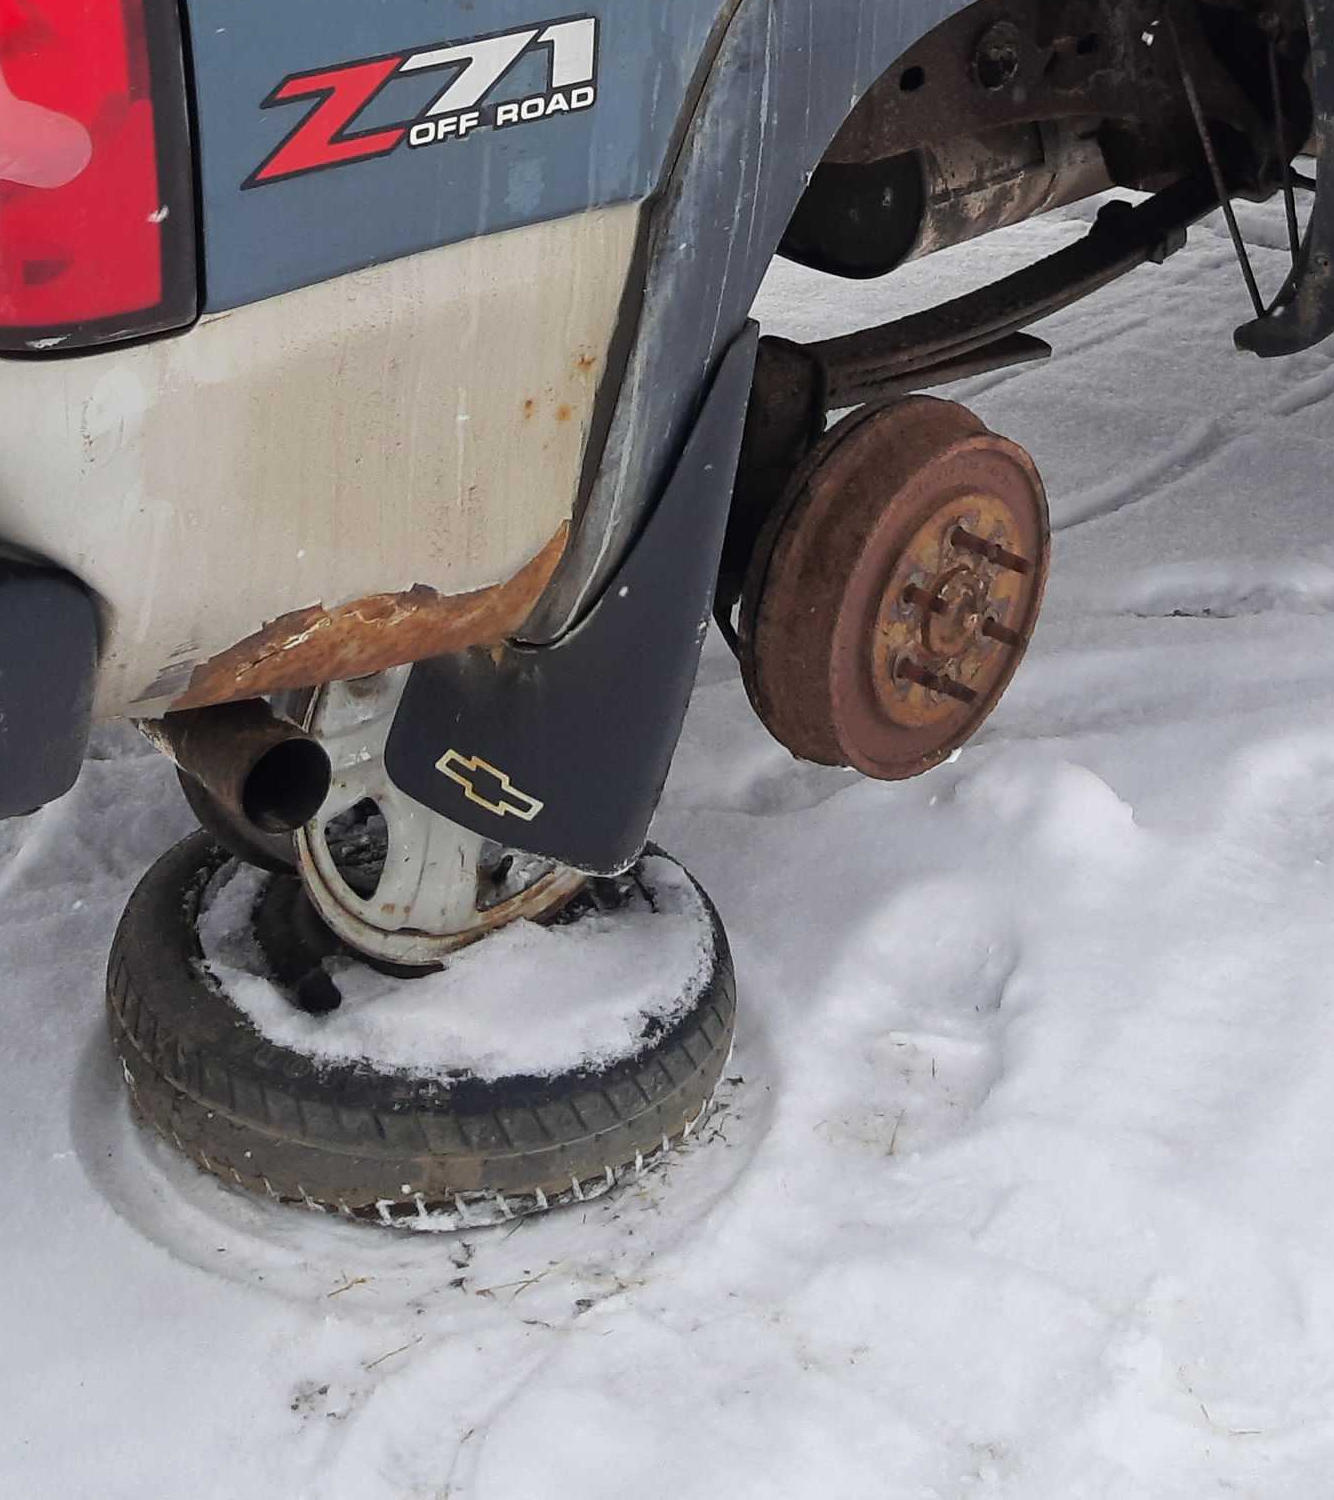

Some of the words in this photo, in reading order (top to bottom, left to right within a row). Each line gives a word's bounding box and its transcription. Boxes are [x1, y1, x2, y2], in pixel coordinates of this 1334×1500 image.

[249, 16, 598, 184] Z71
[408, 111, 480, 148] OFF
[495, 86, 596, 126] ROAD
